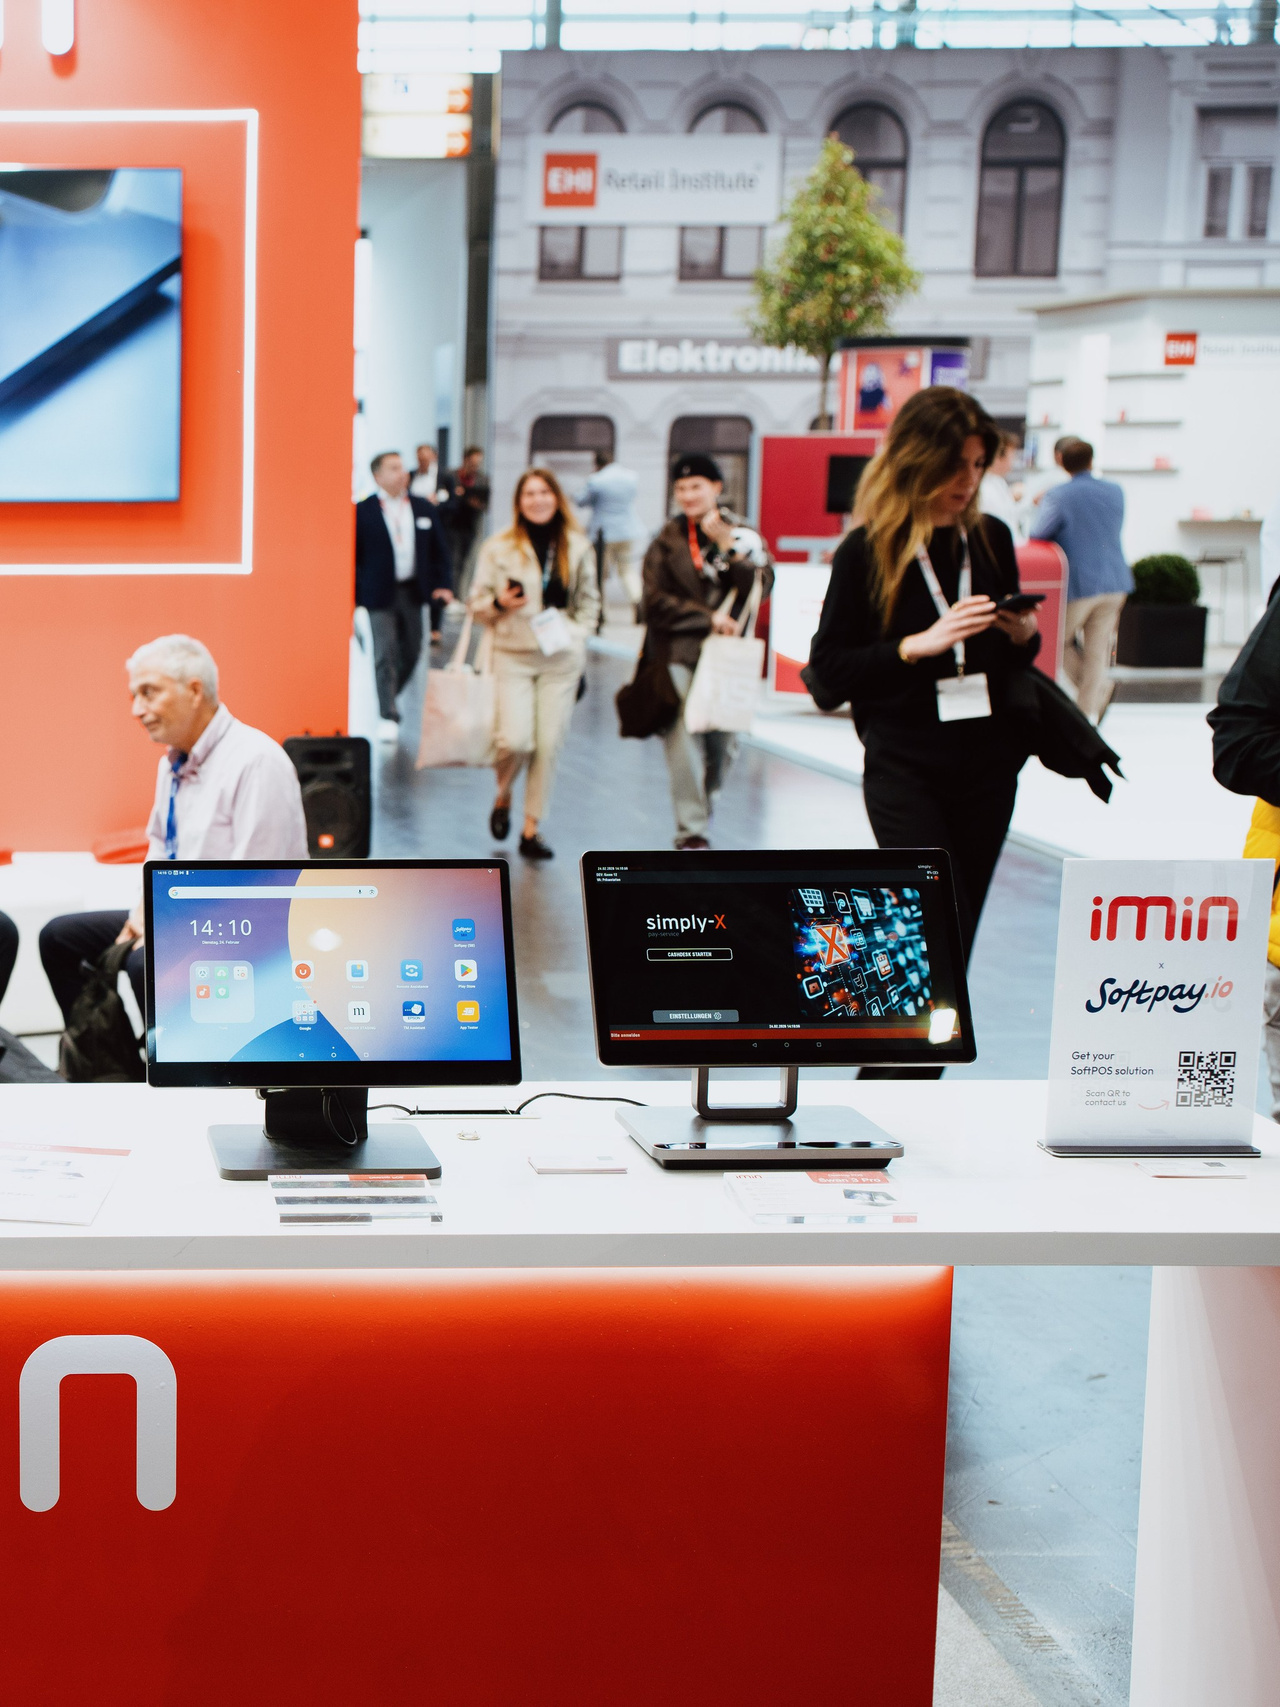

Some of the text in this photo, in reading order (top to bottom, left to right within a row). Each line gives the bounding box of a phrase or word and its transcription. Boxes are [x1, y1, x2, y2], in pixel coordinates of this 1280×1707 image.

[547, 166, 760, 194] EHI Retail Institute
[189, 919, 252, 936] 14:10
[646, 913, 727, 933] simply-X
[1090, 896, 1239, 942] imin
[1085, 975, 1234, 1014] Softpay.io
[353, 1007, 365, 1016] m
[1071, 1051, 1115, 1062] Get your
[1070, 1066, 1154, 1075] SoftPOS solution
[1107, 1090, 1121, 1098] QR
